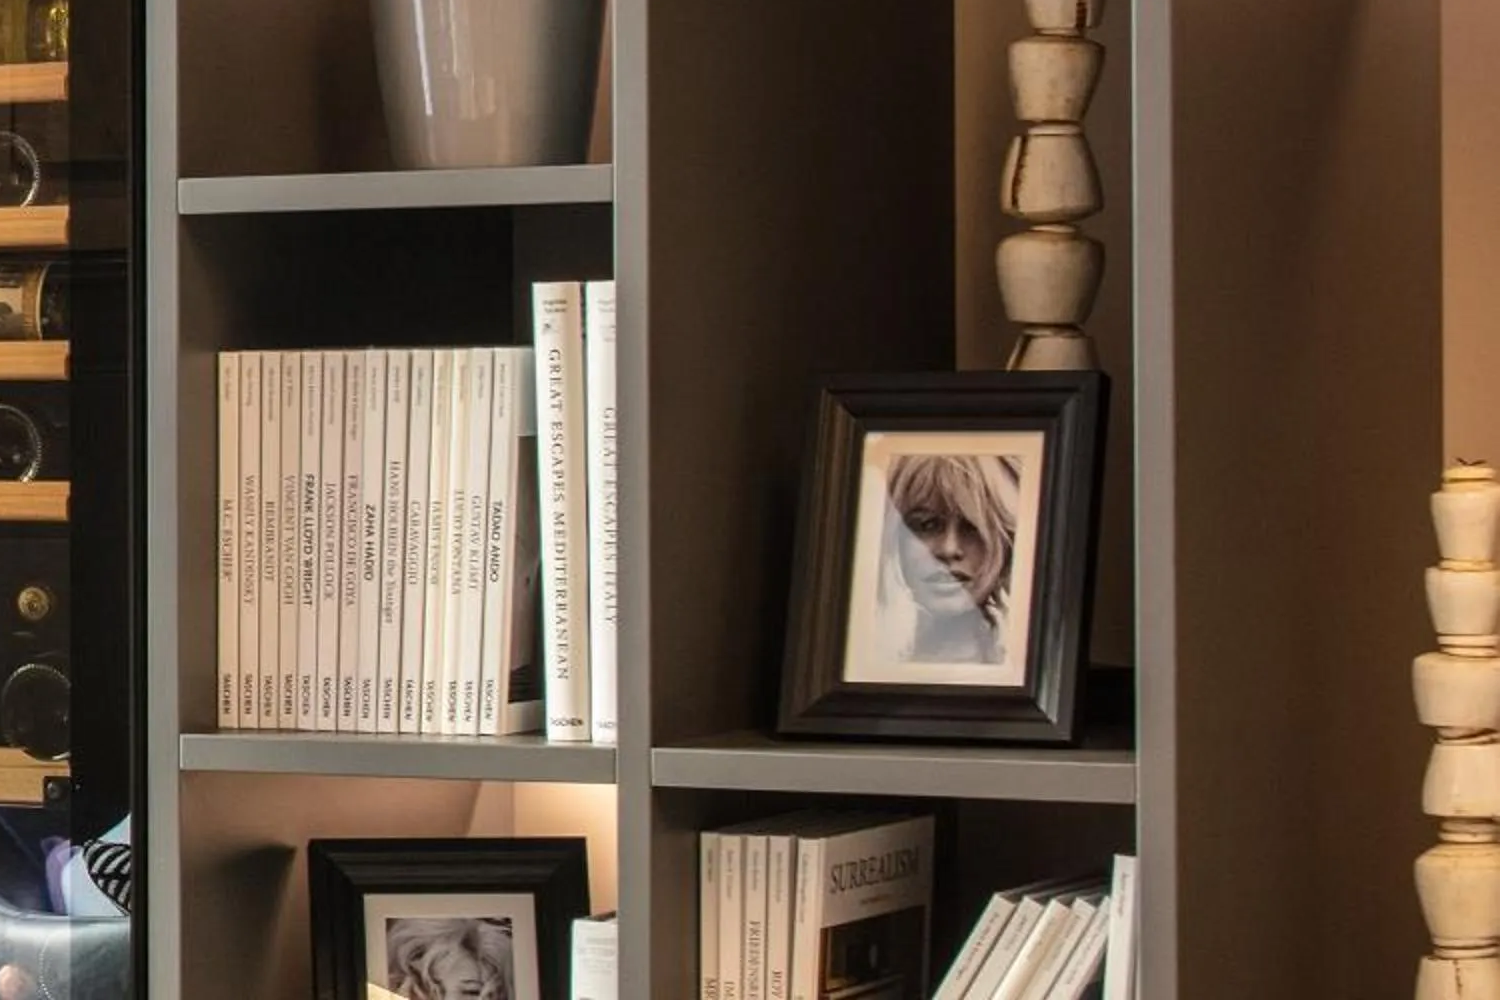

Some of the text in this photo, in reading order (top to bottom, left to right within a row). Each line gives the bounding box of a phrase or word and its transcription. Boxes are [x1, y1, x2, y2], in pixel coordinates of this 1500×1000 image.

[603, 407, 616, 469] GREAT
[388, 460, 401, 496] HANS
[346, 474, 358, 548] FRANCISCO
[387, 500, 399, 555] HOLBEIN
[548, 348, 570, 680] GREAT ESCAPES MEDITERRANEAN
[222, 529, 233, 583] ESCHER
[265, 501, 274, 582] REMBRANDT
[283, 474, 296, 604] VINCENT VAN GOGH
[303, 474, 314, 606] FRANK LLOYD WRIGHT
[323, 482, 336, 600] JACKSON POLLOCK
[363, 504, 376, 581] ZAHA HADID
[407, 500, 421, 585] CARAVAGGIO
[451, 489, 465, 595] LUCIO FONTANA
[468, 495, 482, 590] GUSTAV KLIMT
[489, 500, 502, 583] TADAO ANDO
[243, 531, 254, 606] KANDINSKY
[345, 571, 356, 607] GOYA
[223, 673, 232, 714] TASCHEN
[243, 673, 253, 714] TASCHEN
[263, 675, 273, 716] TASCHEN
[284, 674, 293, 714] TASCHEN
[301, 675, 311, 715] TASCHEN
[342, 677, 352, 716] TASCHEN
[361, 679, 371, 719] TASCHEN
[383, 678, 392, 719] TASCHEN
[404, 679, 414, 720] TASCHEN
[484, 679, 493, 719] TASCHEN
[830, 846, 919, 894] SURREALISM
